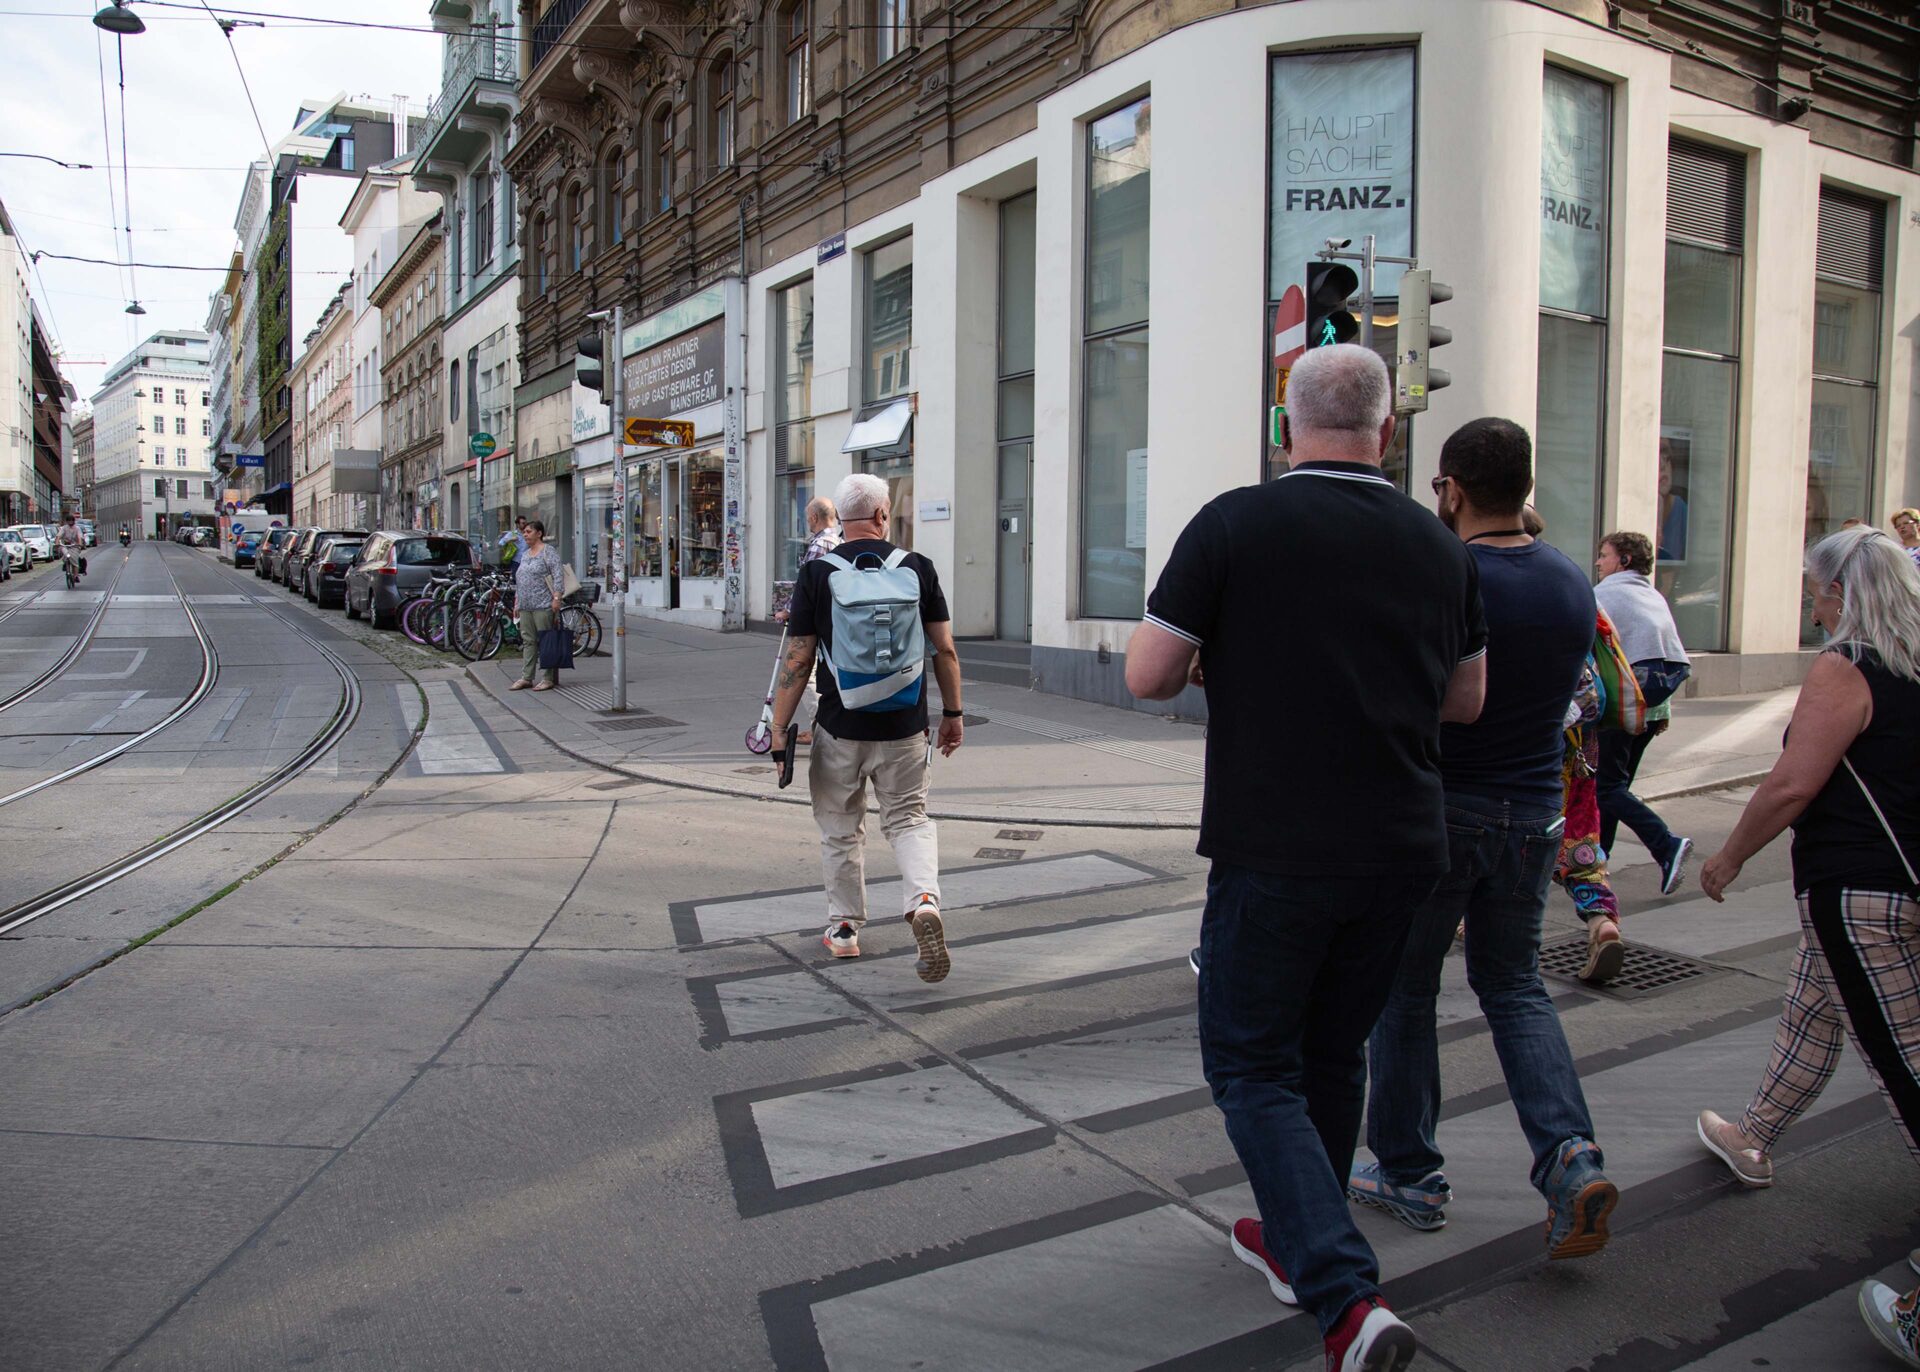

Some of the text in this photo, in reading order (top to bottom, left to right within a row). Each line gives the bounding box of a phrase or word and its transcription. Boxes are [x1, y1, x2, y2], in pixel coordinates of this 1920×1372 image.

[1286, 112, 1395, 143] HAUPT
[1286, 145, 1393, 175] SACHE
[1541, 130, 1595, 169] AUPT
[1541, 160, 1594, 195] ACHE
[1286, 185, 1405, 211] FRANZ.
[663, 336, 700, 362] PRANTNER
[628, 354, 697, 392] KURATIERTES DESIGN
[703, 368, 715, 386] OF
[670, 384, 718, 412] MAINSTREAM
